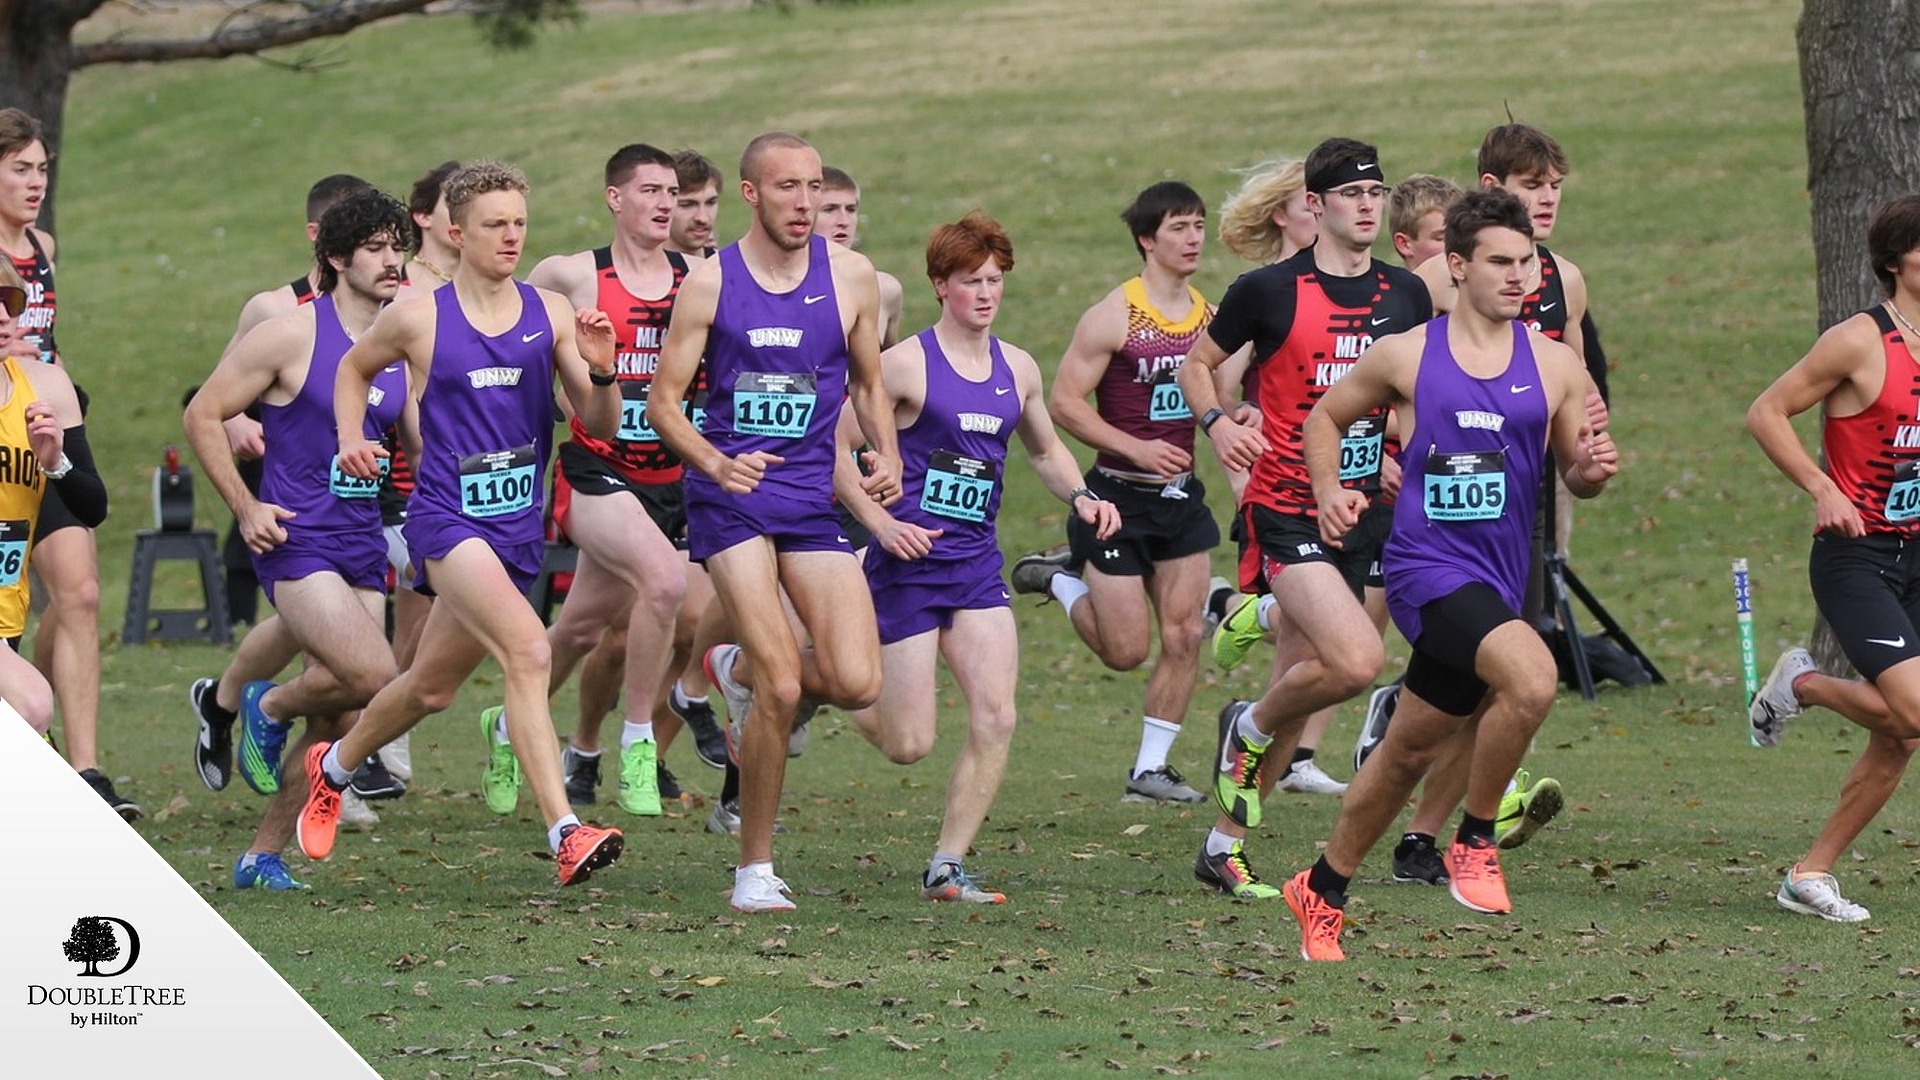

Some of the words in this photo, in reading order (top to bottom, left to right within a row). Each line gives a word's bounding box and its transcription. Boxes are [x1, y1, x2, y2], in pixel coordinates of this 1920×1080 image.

[27, 282, 44, 303] LC
[746, 327, 804, 348] UNW
[617, 352, 659, 374] KNIG
[467, 367, 523, 388] UNW
[1154, 390, 1187, 411] 10
[621, 407, 651, 431] 10
[738, 400, 812, 427] 1107
[957, 411, 1004, 435] UNW
[1455, 410, 1505, 432] UNW
[1893, 424, 1920, 447] KN
[1340, 442, 1378, 470] 033
[466, 474, 532, 506] 1100
[926, 478, 990, 512] 1101
[1429, 481, 1502, 509] 1105
